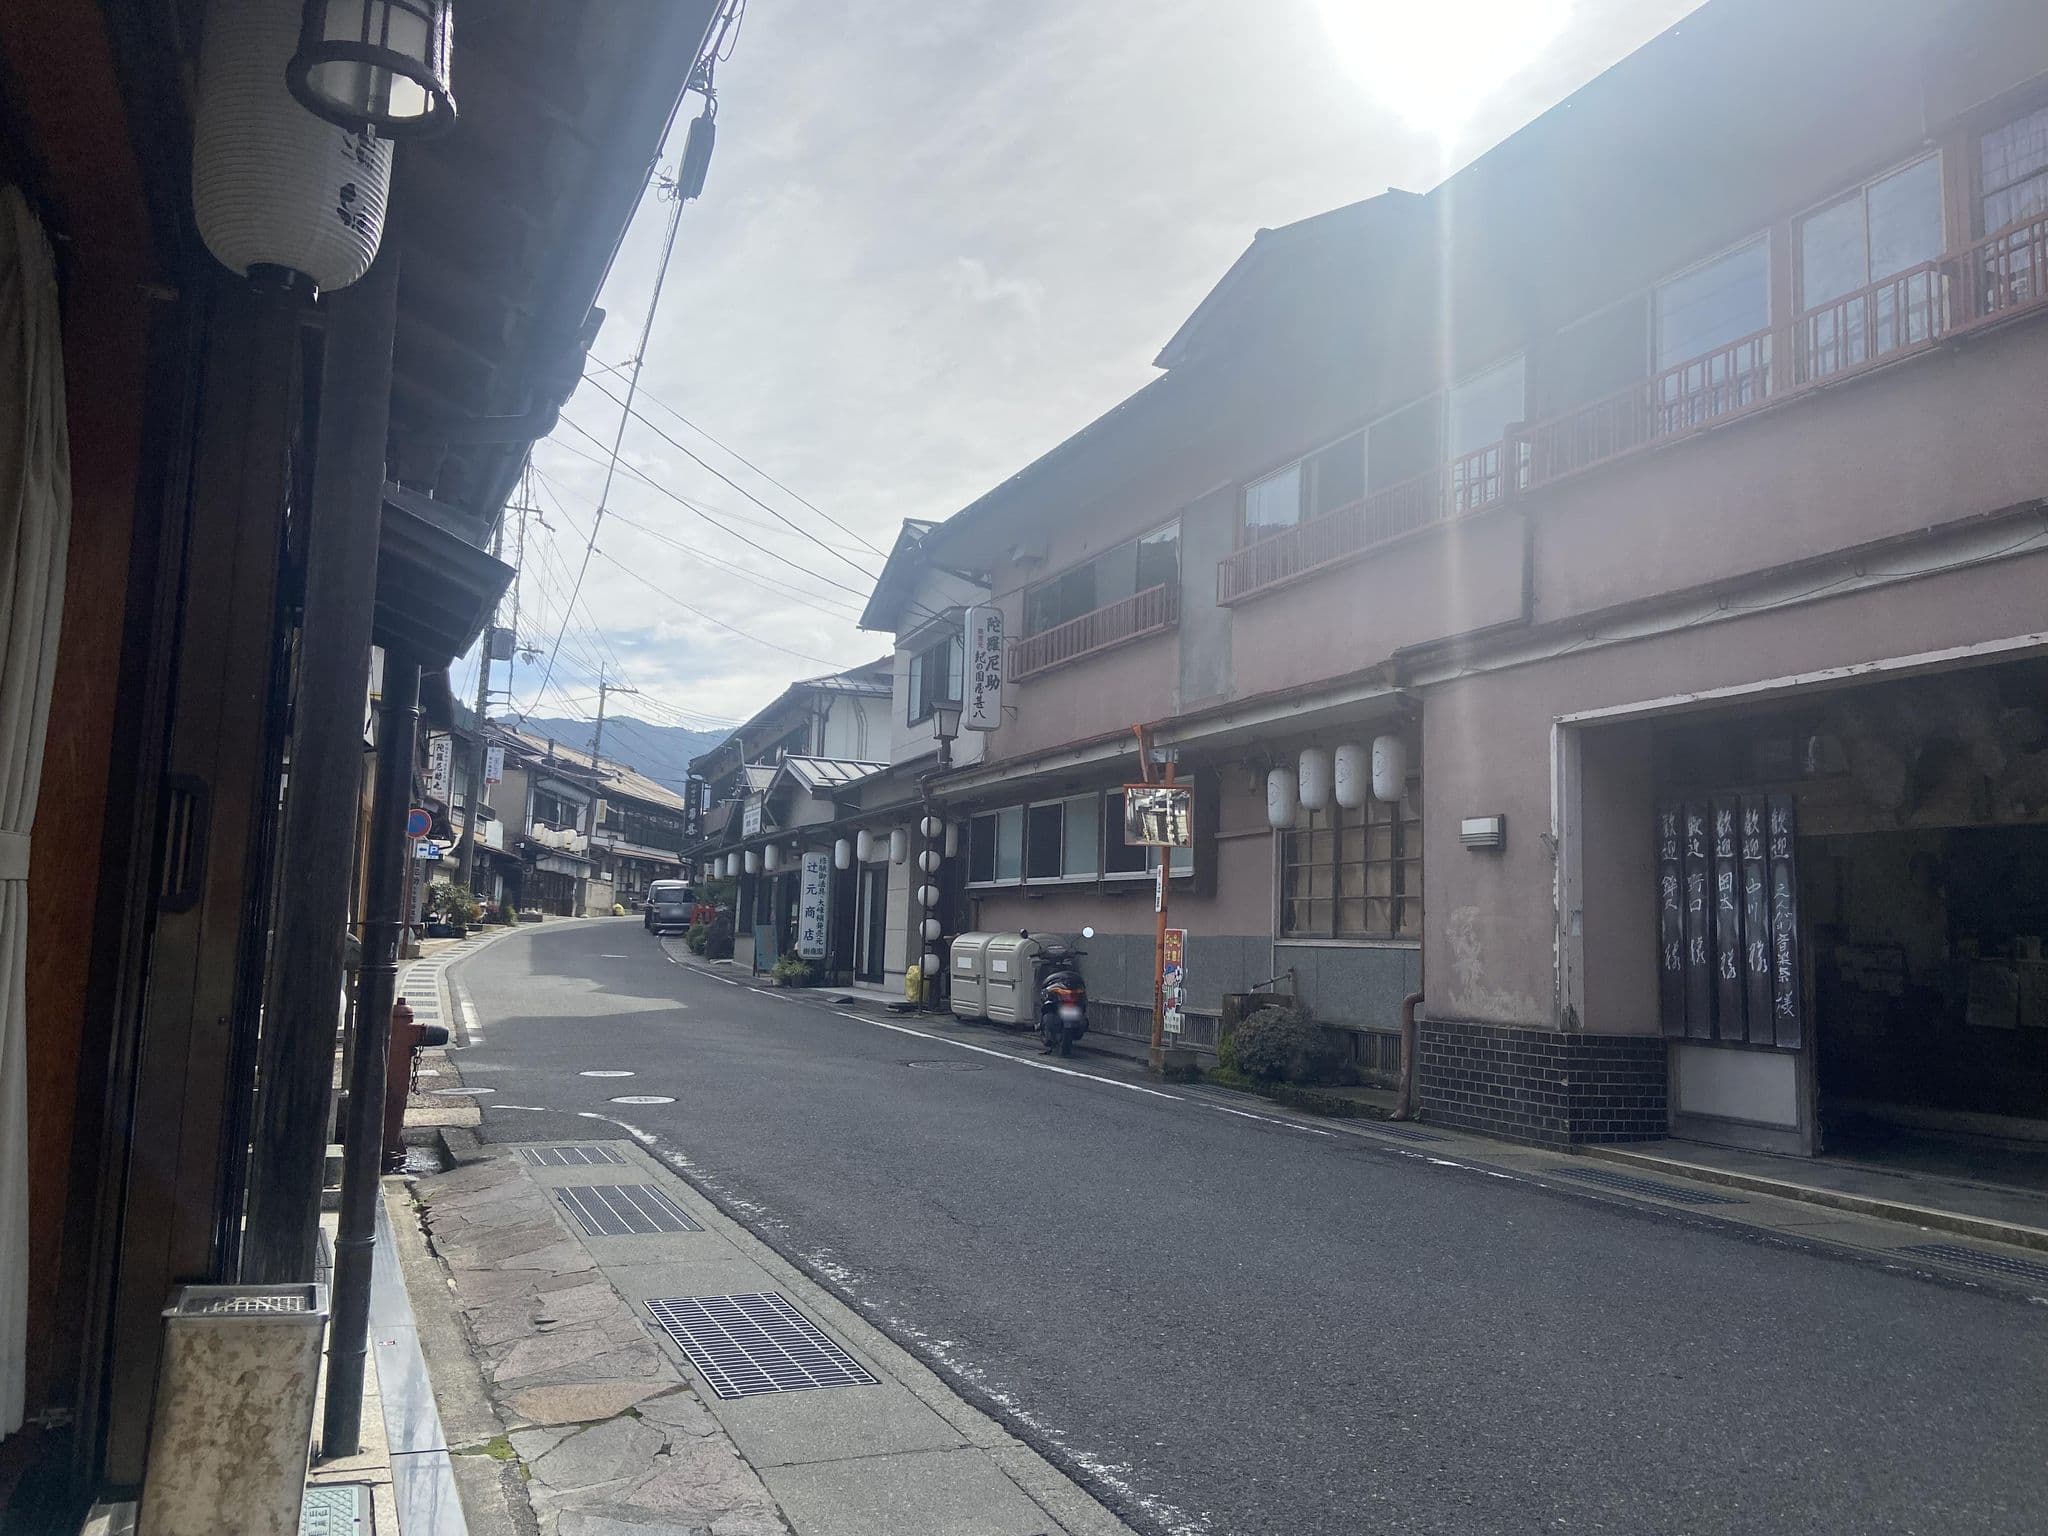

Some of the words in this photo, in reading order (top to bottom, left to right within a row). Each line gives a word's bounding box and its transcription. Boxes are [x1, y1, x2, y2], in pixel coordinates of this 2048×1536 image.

[986, 616, 1001, 691] 陀羅尼助
[1716, 810, 1734, 858] 歓迎
[1743, 808, 1762, 860] 歓迎
[1771, 808, 1790, 859] 歓迎
[804, 862, 818, 941] 辻元商店
[1687, 873, 1704, 912] 野口
